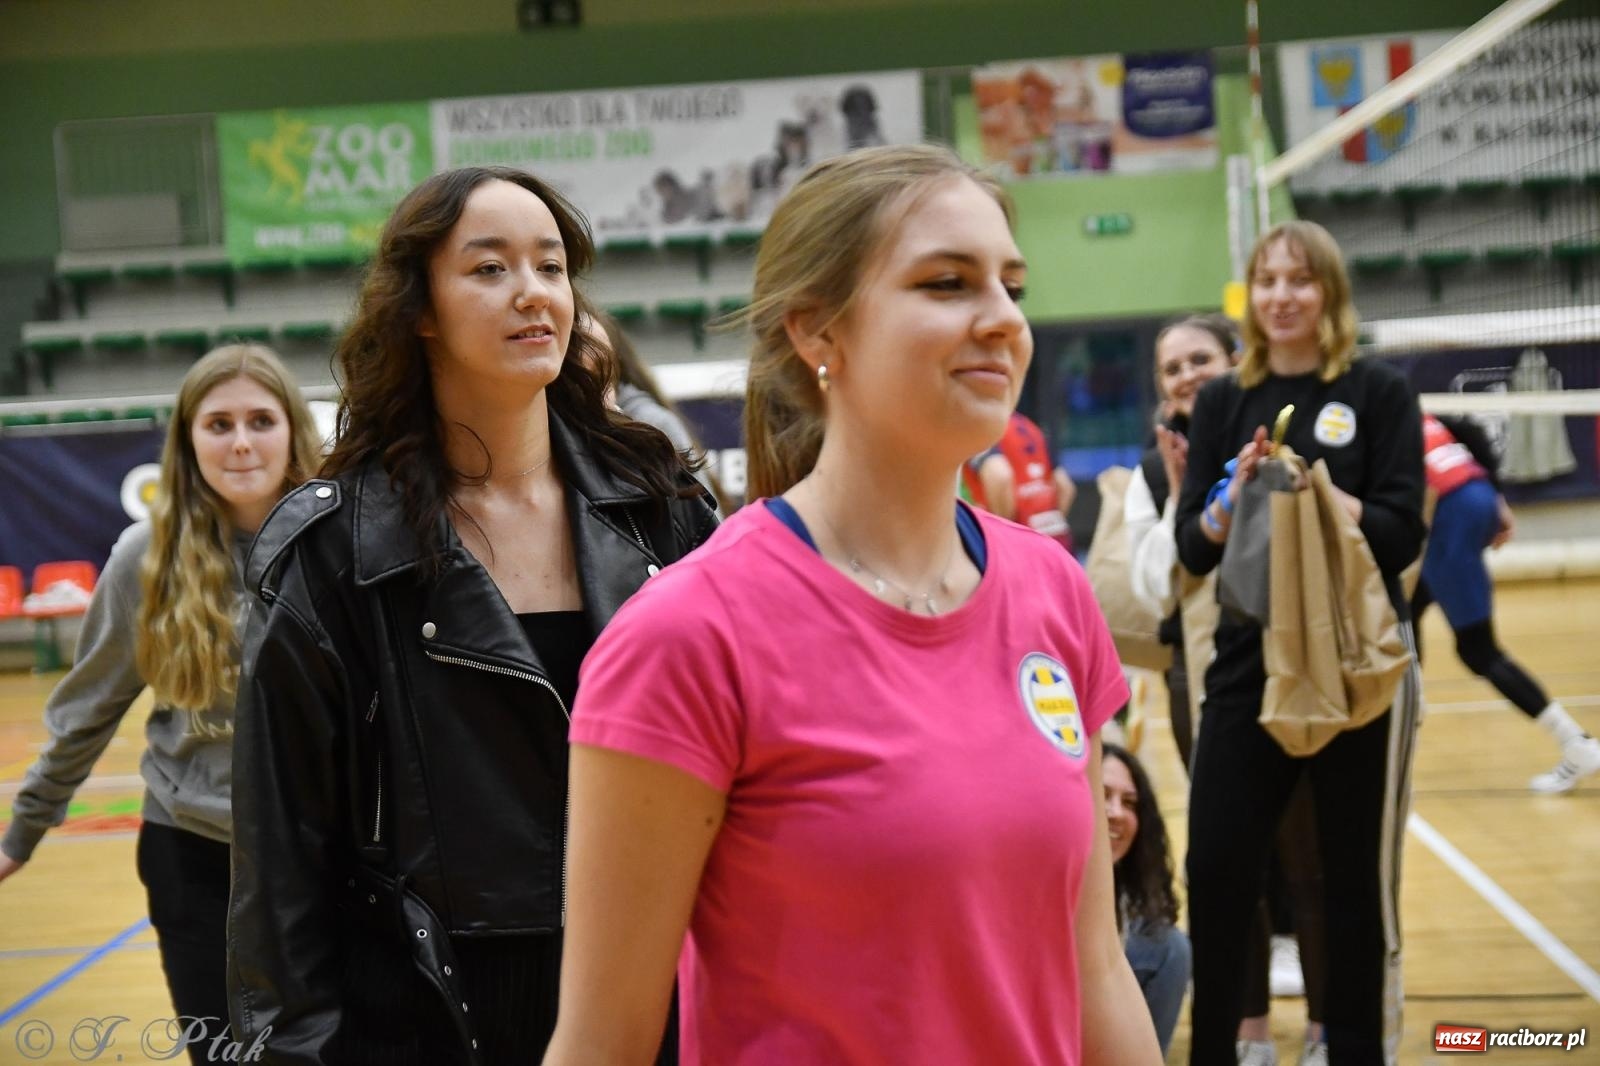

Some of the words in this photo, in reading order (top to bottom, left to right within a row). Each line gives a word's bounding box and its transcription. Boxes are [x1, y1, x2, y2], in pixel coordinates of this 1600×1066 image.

[580, 94, 628, 126] DLA
[635, 86, 743, 123] TWOJEGO
[308, 122, 415, 161] ZOO
[303, 155, 412, 197] MAR
